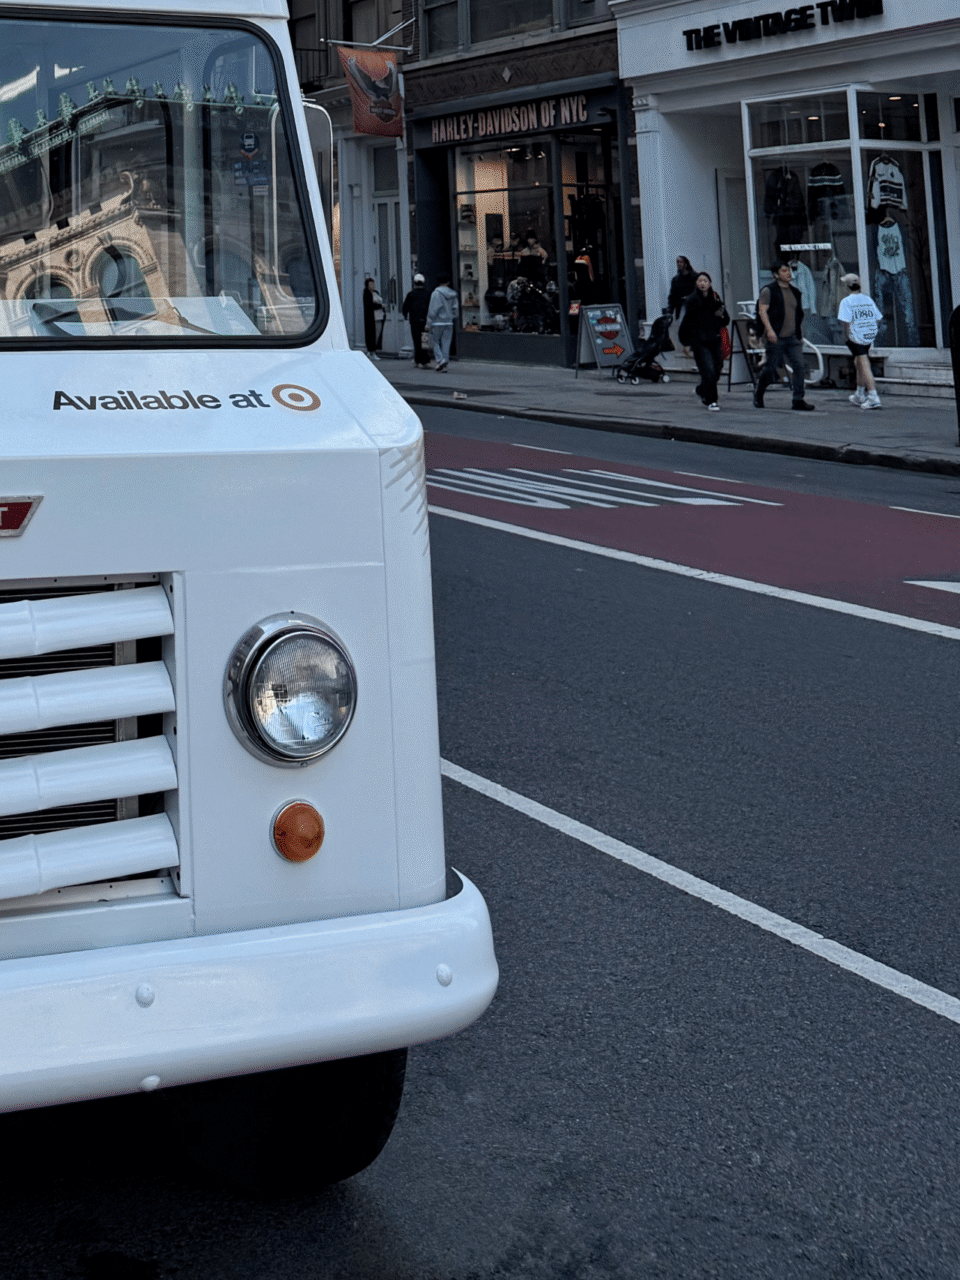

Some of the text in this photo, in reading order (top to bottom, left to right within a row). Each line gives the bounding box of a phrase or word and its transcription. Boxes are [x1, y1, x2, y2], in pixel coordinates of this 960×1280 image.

[682, 24, 722, 51] THE
[722, 4, 816, 44] VINTAGE
[431, 94, 588, 143] HARLEY-DAVIDSON OF NYC
[53, 389, 271, 411] Available at
